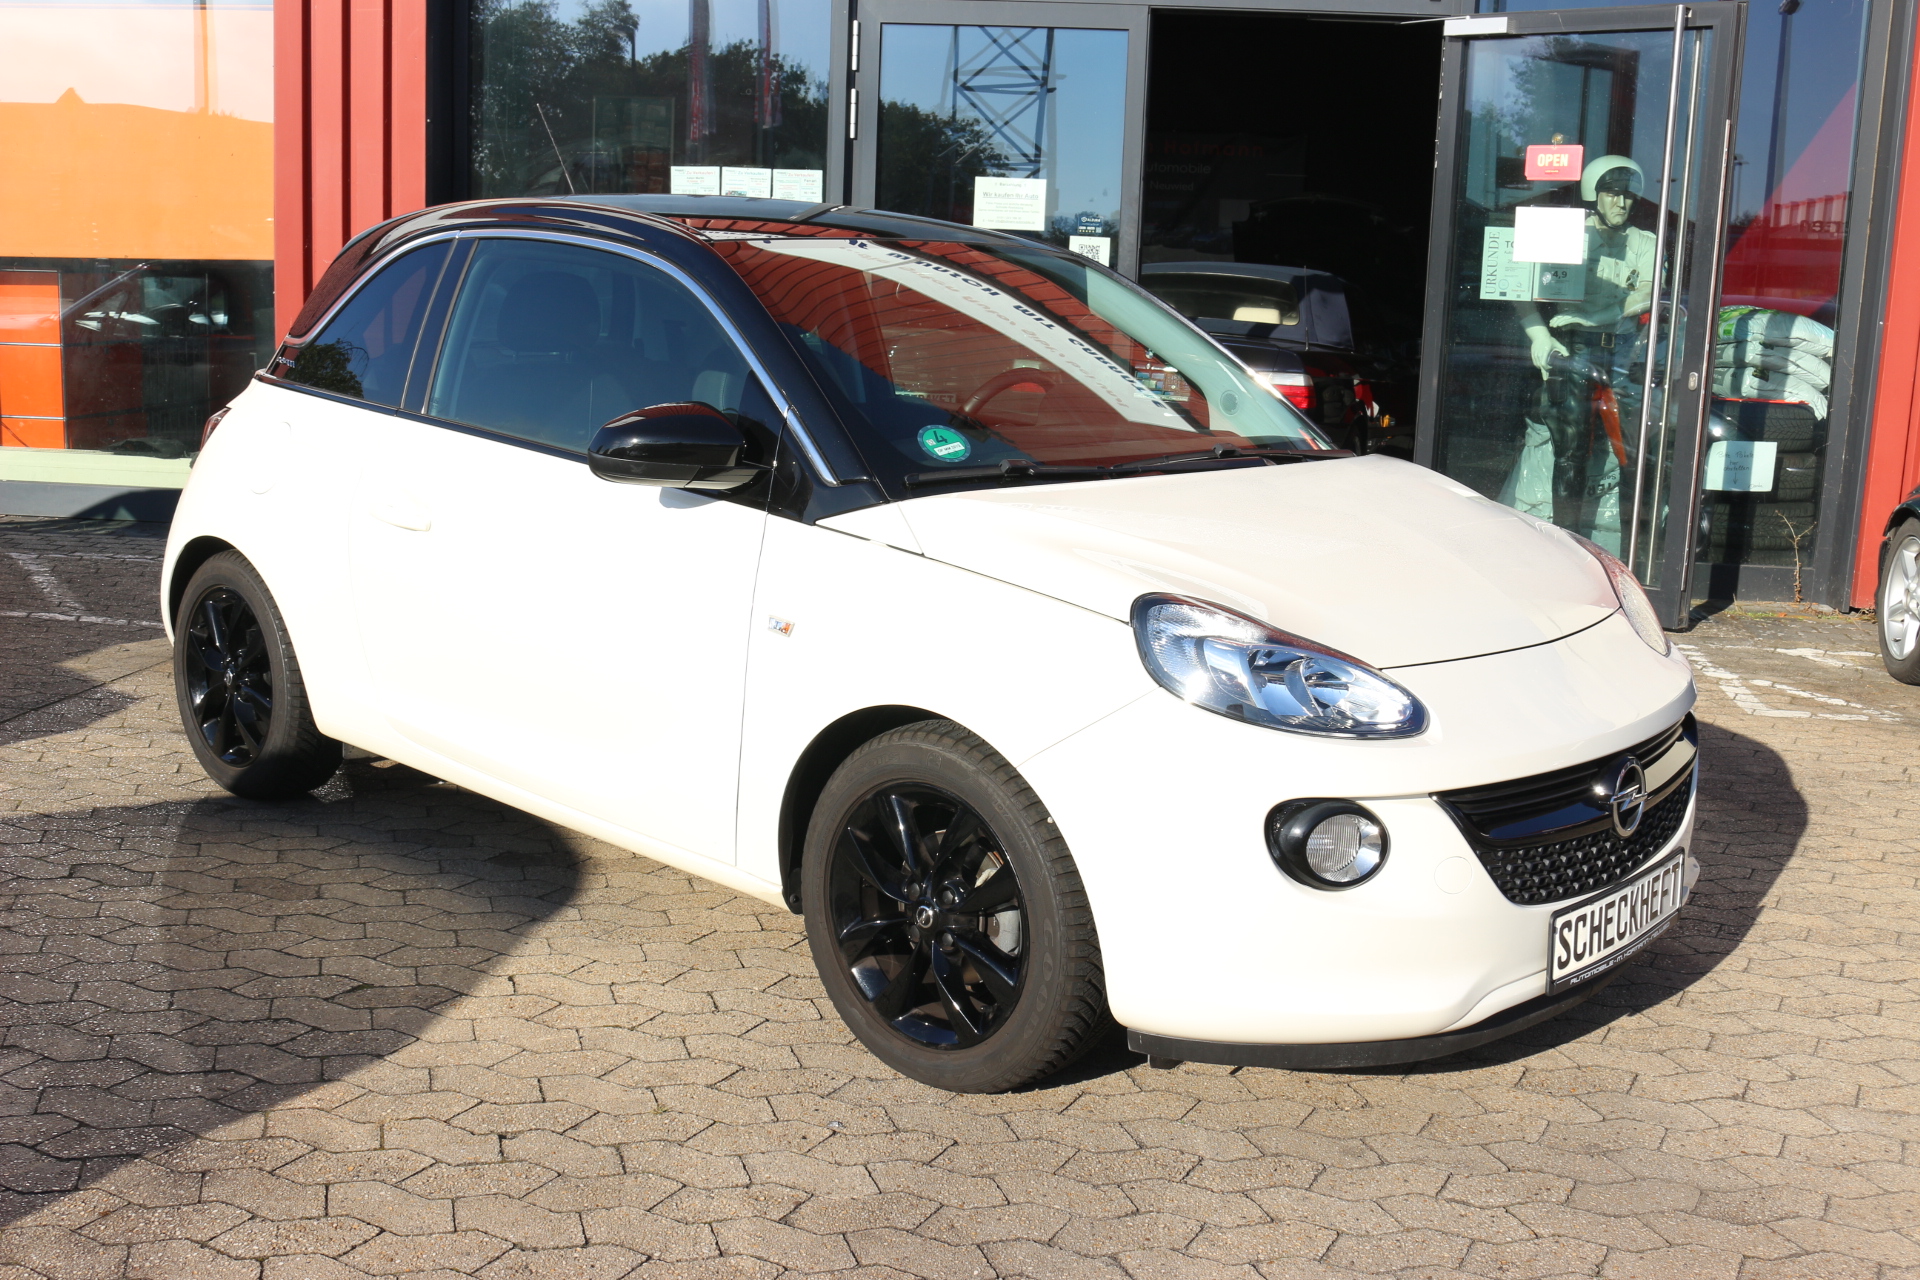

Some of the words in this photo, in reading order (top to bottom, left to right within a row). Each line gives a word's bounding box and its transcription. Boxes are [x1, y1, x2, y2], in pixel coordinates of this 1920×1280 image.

[1537, 153, 1569, 167] OPEN
[1145, 162, 1212, 174] utomobile
[1149, 180, 1195, 191] Neuwied
[1485, 231, 1501, 296] URKUNDE
[1552, 270, 1568, 279] 4,9
[933, 430, 948, 443] 4
[1557, 862, 1681, 970] SCHECKHEFT
